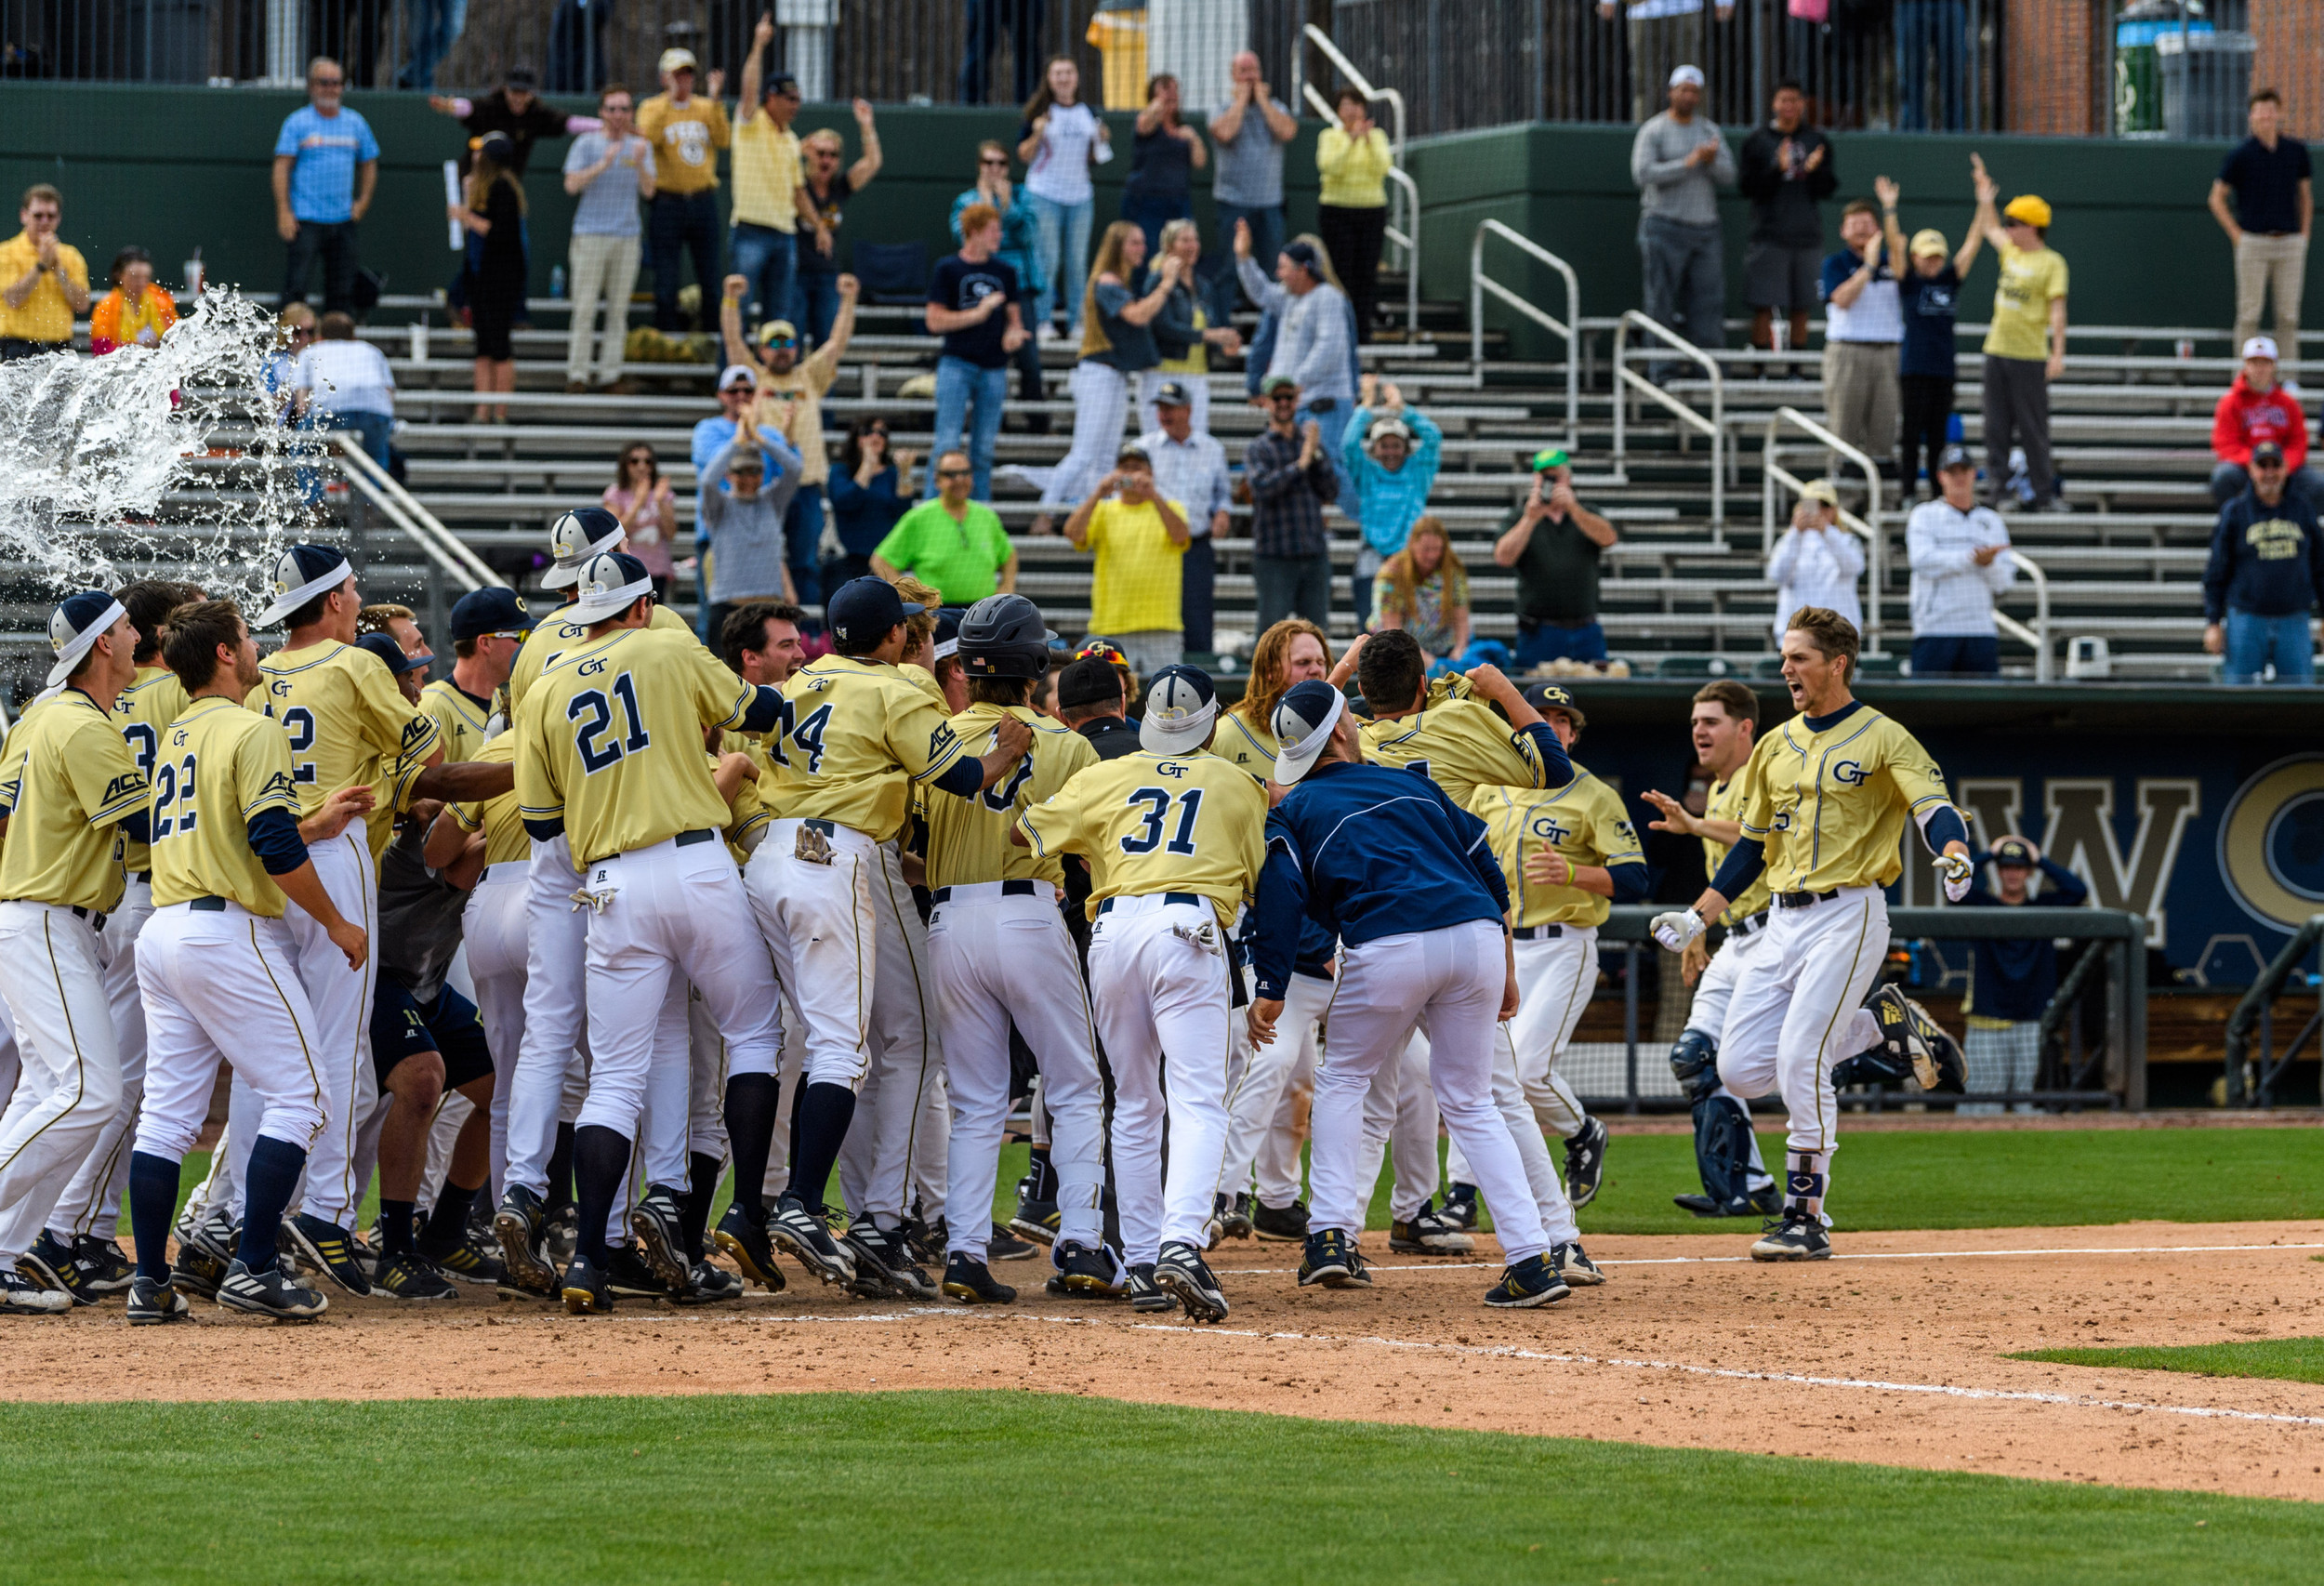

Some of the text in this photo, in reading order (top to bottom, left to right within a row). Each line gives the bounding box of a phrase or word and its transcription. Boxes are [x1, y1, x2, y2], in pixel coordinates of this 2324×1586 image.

[577, 657, 607, 677] GT
[987, 665, 996, 674] 10
[271, 680, 292, 697] GT
[807, 678, 828, 693] GT
[1543, 687, 1569, 704] GT
[565, 669, 651, 777] 21
[769, 699, 835, 775] 14
[173, 729, 189, 747] GT
[262, 702, 317, 786] 2
[927, 720, 957, 763] ACC
[1156, 761, 1189, 779] GT
[1832, 760, 1873, 787] GT
[100, 773, 149, 807] ACC
[151, 751, 196, 847] 22
[1119, 786, 1205, 858] 31
[1533, 817, 1570, 846] GT
